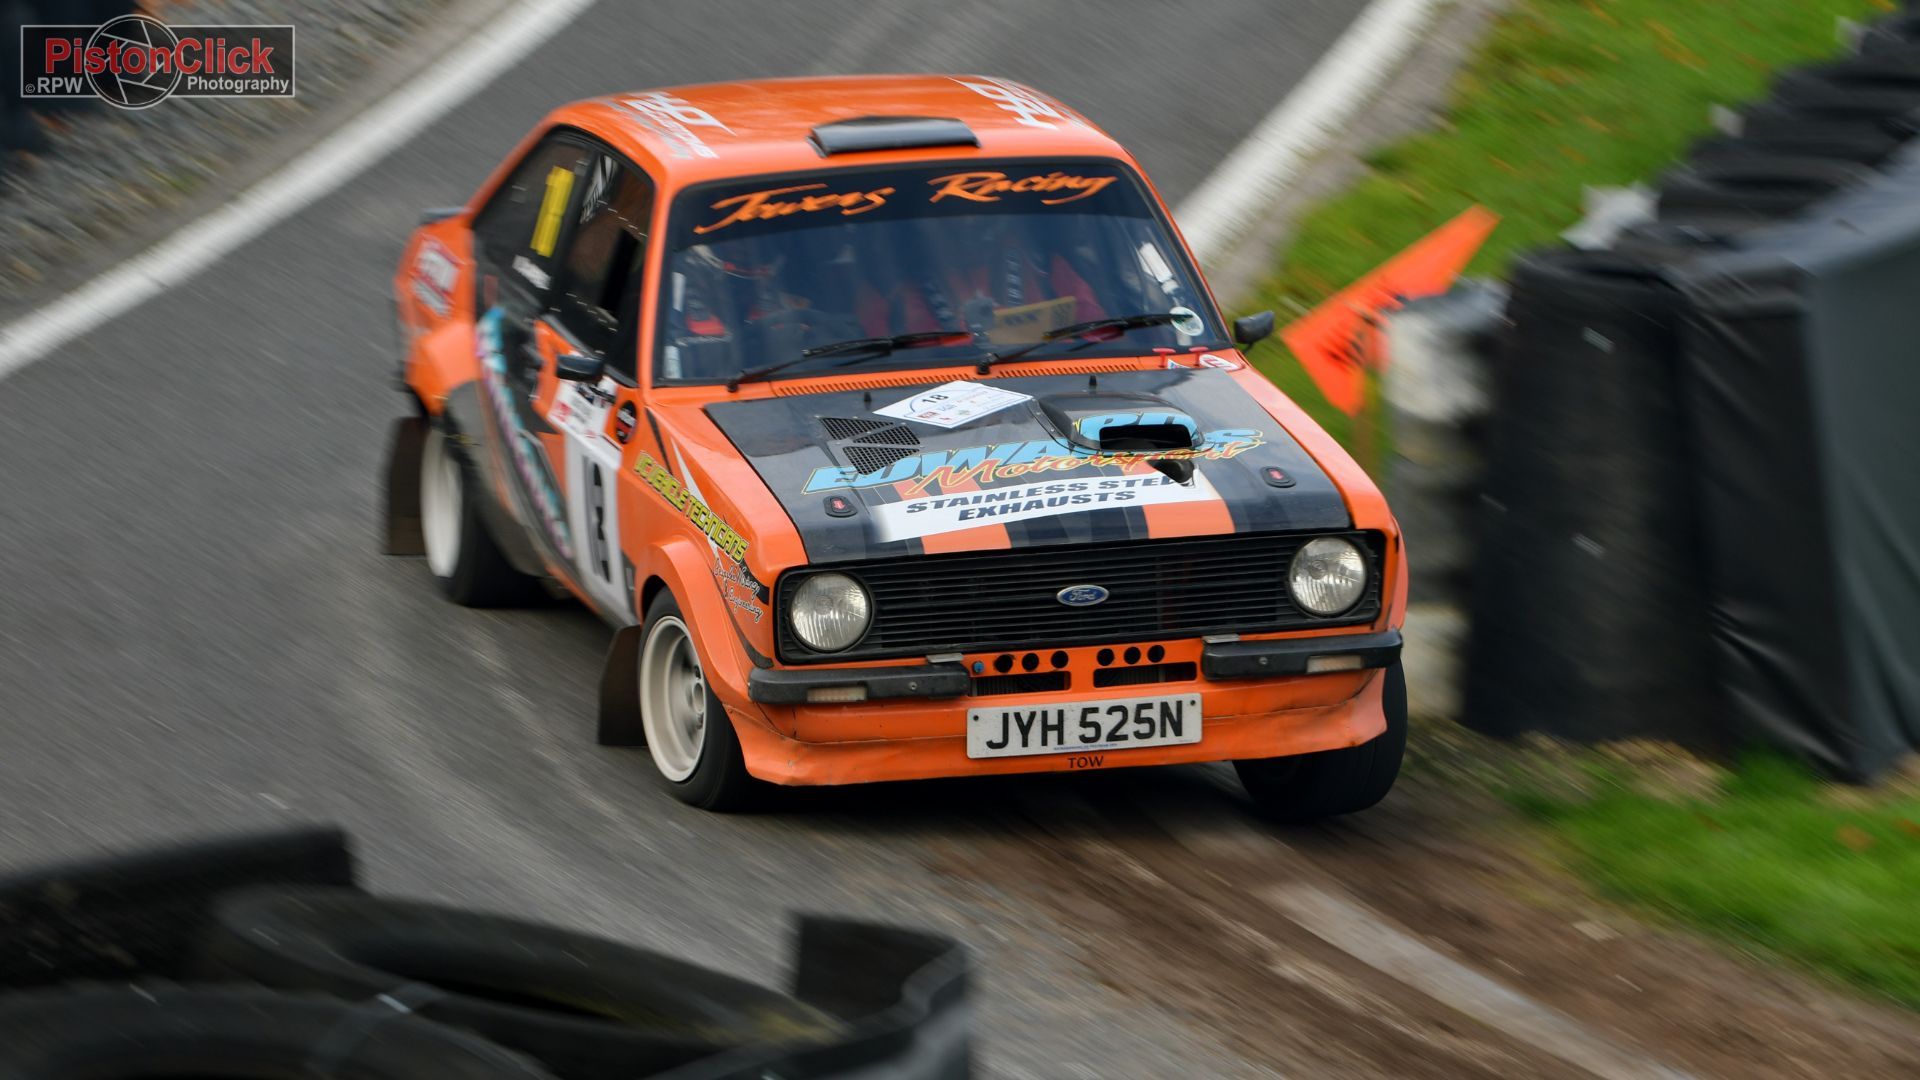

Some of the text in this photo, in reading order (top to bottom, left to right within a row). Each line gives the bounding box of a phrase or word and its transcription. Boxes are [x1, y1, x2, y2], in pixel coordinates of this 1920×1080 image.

[927, 171, 1118, 205] Racing
[922, 394, 949, 404] 18
[903, 439, 1246, 497] Motorsport
[906, 482, 1088, 514] STAINLESS
[958, 491, 1136, 521] EXHAUSTS
[985, 700, 1183, 750] JYH 525N
[1067, 755, 1104, 769] TOW
